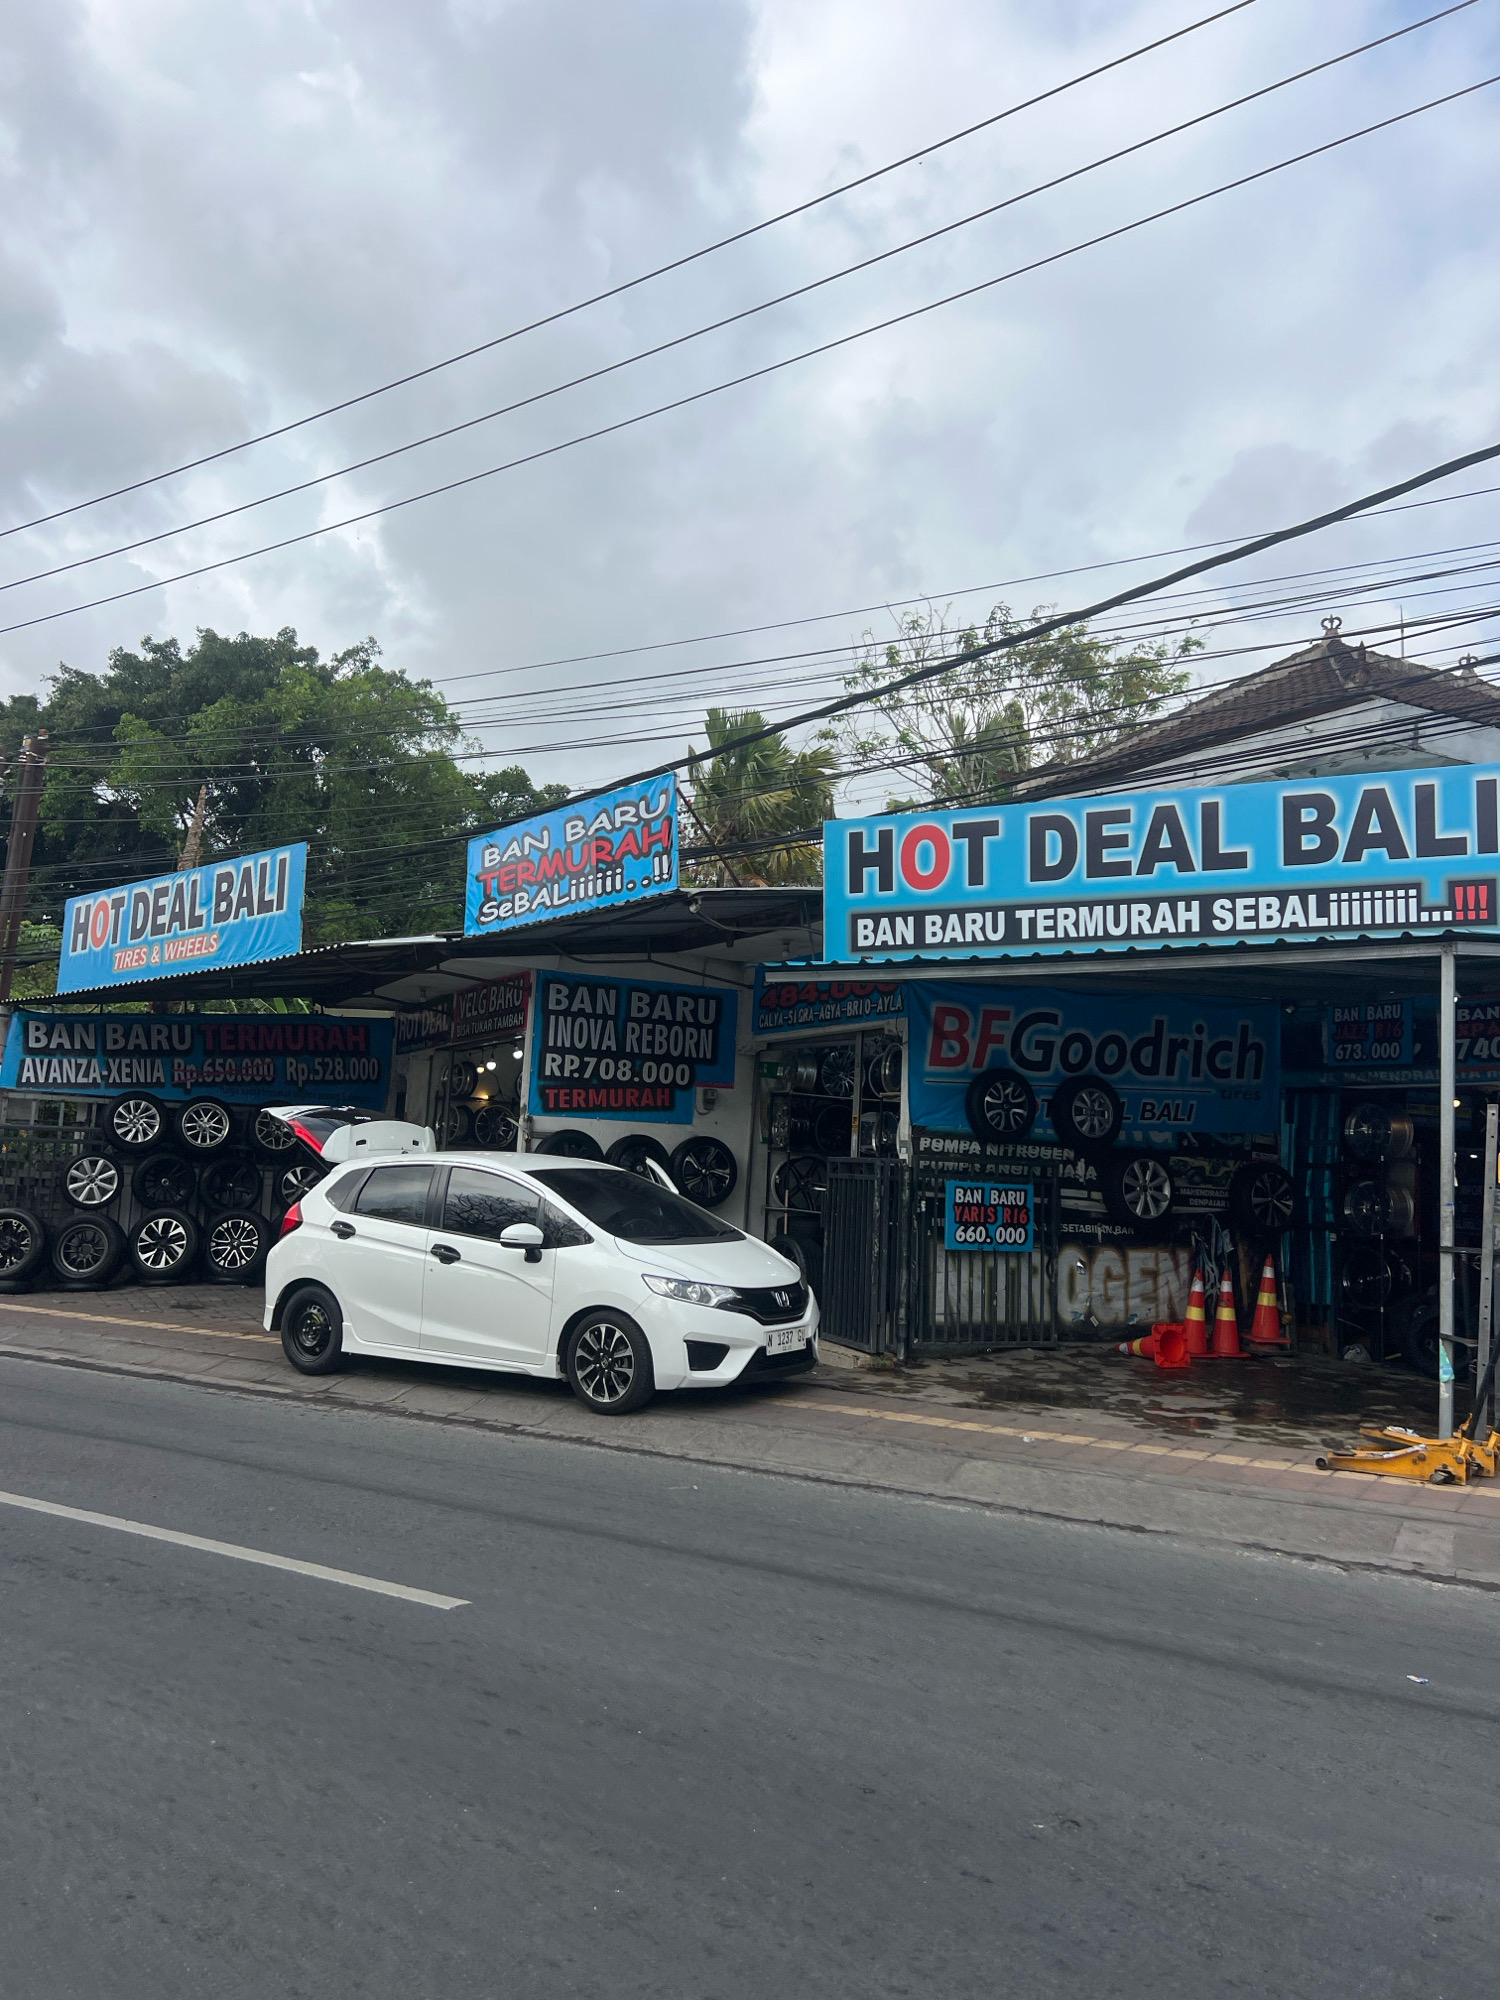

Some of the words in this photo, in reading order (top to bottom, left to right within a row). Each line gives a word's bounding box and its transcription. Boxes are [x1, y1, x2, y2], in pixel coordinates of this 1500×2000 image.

[484, 829, 550, 868] BAN
[565, 793, 668, 843] BARU
[848, 818, 1001, 895] HOT
[1029, 800, 1249, 884] DEAL
[1282, 778, 1500, 868] BALI
[478, 819, 670, 895] TERMURAH
[71, 894, 126, 953] HOT
[129, 878, 204, 942] DEAL
[212, 857, 288, 926] BALI
[856, 915, 915, 948] BAN
[924, 910, 1006, 945] BARU
[1015, 900, 1201, 941] TERMURAH
[113, 948, 148, 971] TIRES
[150, 945, 161, 965] &
[163, 934, 219, 962] WHEELS
[459, 988, 488, 1019] VELG
[488, 978, 524, 1013] BARU
[547, 983, 617, 1016] BAN
[630, 991, 717, 1025] BARU
[1334, 1007, 1359, 1023] BAN
[1366, 1004, 1402, 1021] BARU
[1456, 1006, 1500, 1022] BAN
[28, 1020, 96, 1050] BAN
[105, 1023, 192, 1051] BARU
[204, 1024, 367, 1053] TERMURAH
[456, 1023, 470, 1038] BISA
[471, 1018, 493, 1035] TUKAR
[493, 1011, 525, 1030] TAMBAH
[547, 1014, 617, 1052] INOVA
[625, 1021, 714, 1060] REBORN
[21, 1057, 166, 1084] AVANZA-XENIA
[173, 1058, 275, 1090] Rp.650.000
[285, 1057, 380, 1088] Rp.528.000
[544, 1052, 691, 1086] RP.708.000
[544, 1087, 671, 1109] TERMURAH
[1138, 1101, 1195, 1122] BALI
[919, 1137, 982, 1156] POMPA
[985, 1142, 1075, 1161] NITROGEN
[954, 1187, 982, 1204] BAN
[990, 1189, 1026, 1206] BARU
[953, 1205, 996, 1223] YARIS
[777, 1330, 794, 1346] 1237
